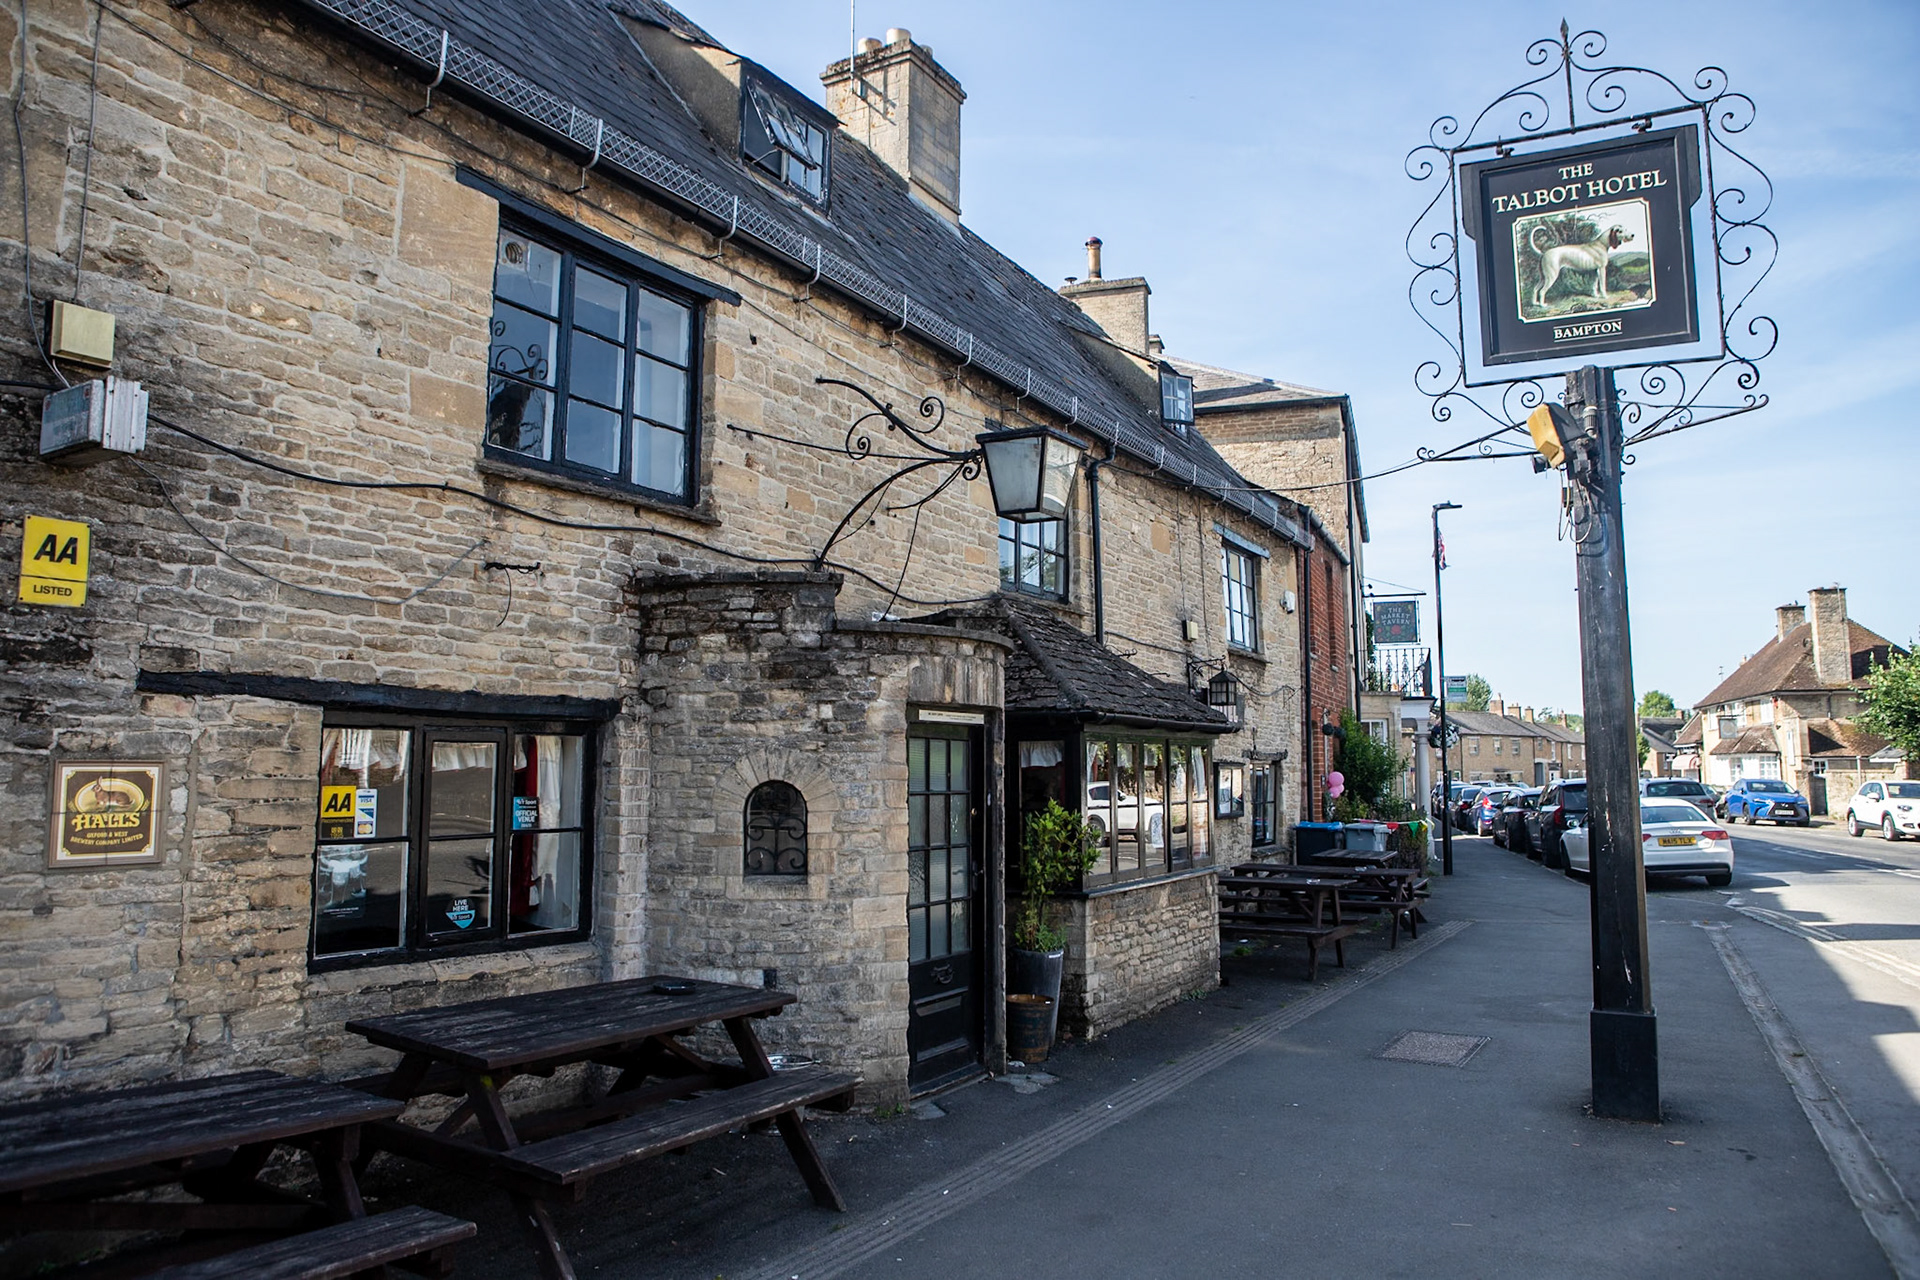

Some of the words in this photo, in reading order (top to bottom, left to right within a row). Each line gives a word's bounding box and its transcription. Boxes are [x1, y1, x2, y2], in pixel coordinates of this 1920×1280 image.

[1558, 162, 1594, 181] THE
[1492, 183, 1582, 214] TALBOT
[1587, 169, 1668, 199] HOTEL
[1553, 321, 1623, 340] BAMPTON
[34, 534, 78, 565] AA
[33, 585, 73, 597] LISTED
[324, 793, 351, 813] AA
[515, 809, 538, 817] OFFICIAL
[518, 815, 535, 823] VENUE
[70, 836, 94, 845] BREWERY
[122, 833, 143, 843] LIMITED
